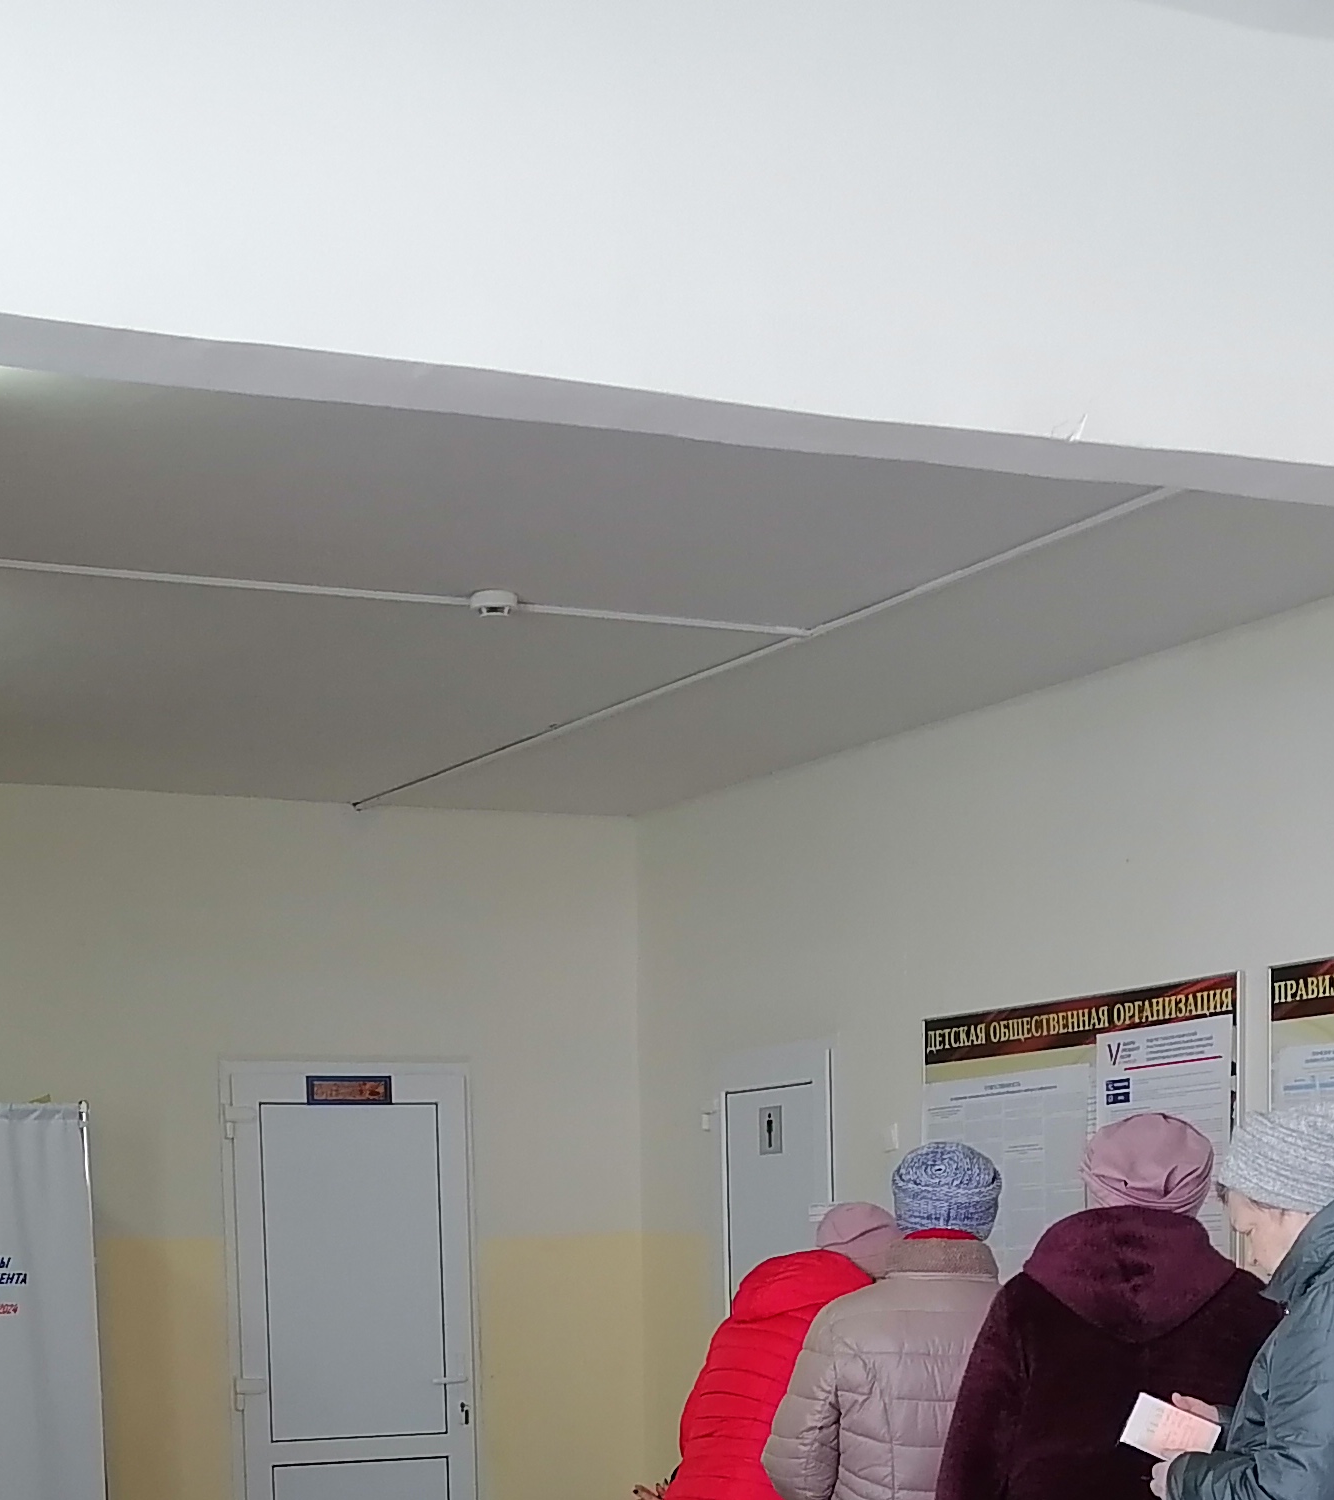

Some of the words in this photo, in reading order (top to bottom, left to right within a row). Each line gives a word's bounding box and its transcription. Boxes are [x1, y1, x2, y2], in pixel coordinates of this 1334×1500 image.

[926, 1023, 986, 1054] ДЕТСКАЯ
[989, 1006, 1109, 1042] ОБЩЕСТВЕННАЯ
[1113, 987, 1233, 1025] ОРГАНИЗАЦИЯ
